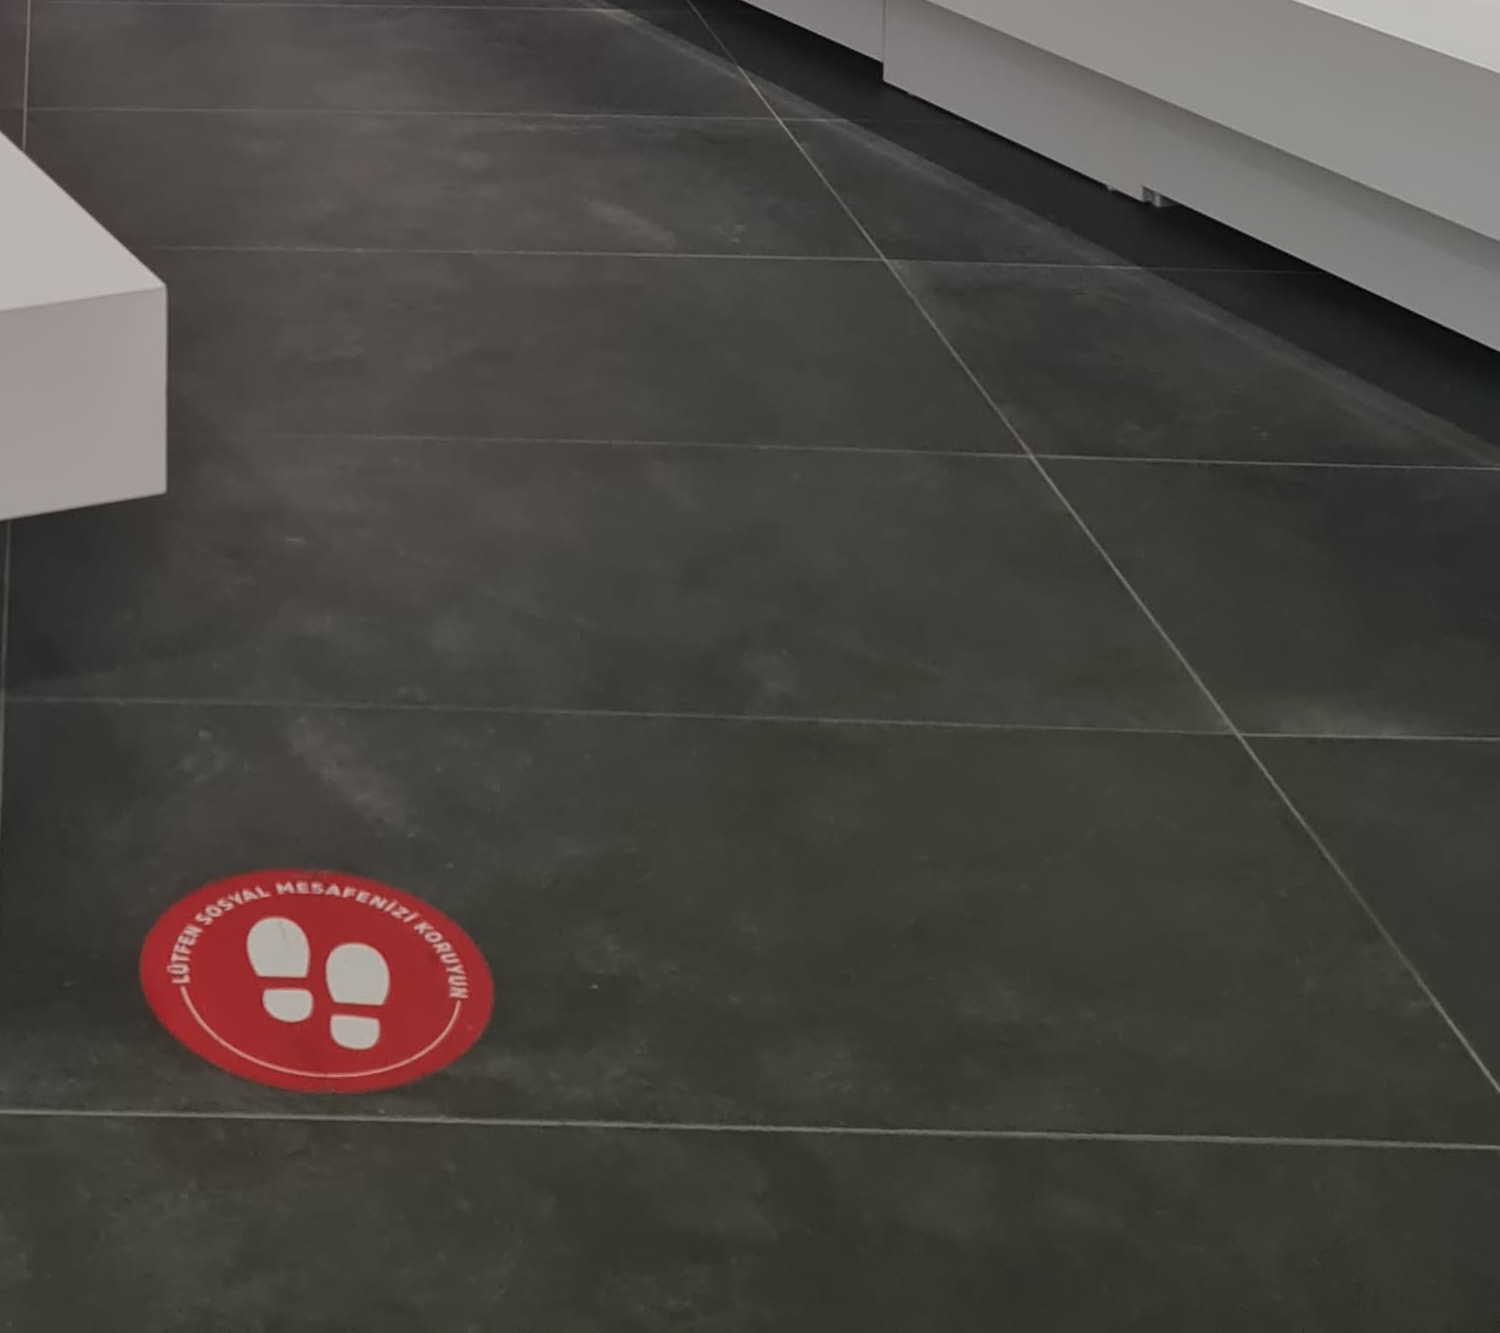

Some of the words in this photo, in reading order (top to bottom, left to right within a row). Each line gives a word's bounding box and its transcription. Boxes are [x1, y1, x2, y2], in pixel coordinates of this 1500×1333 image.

[167, 924, 204, 986] LÜTFEN
[194, 884, 273, 926] SOSYAL
[274, 881, 419, 925] MESAFENİZİ
[412, 921, 469, 1000] KORUYUN
